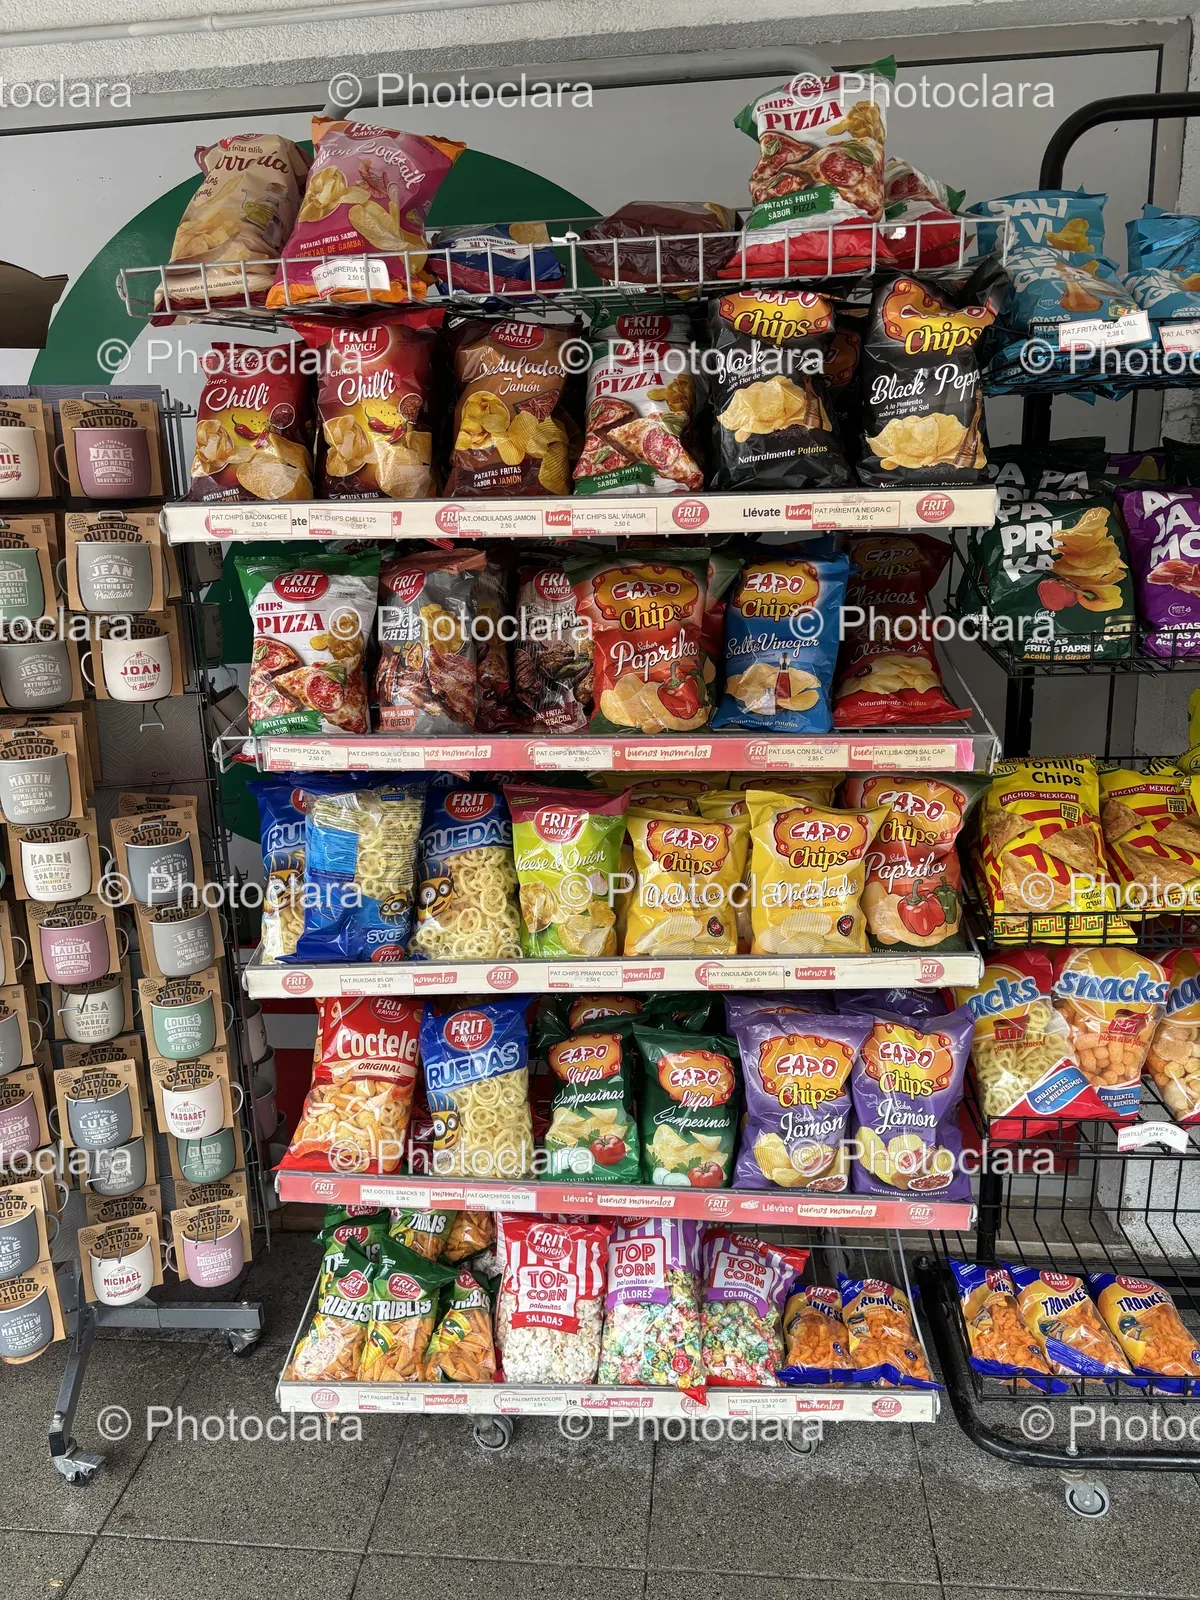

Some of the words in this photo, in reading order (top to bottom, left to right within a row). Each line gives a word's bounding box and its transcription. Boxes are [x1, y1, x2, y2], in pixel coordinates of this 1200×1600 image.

[764, 101, 843, 131] PIZZA
[763, 196, 793, 211] PATATAS
[795, 191, 820, 204] FRITAS
[988, 198, 1074, 218] SALT
[768, 208, 791, 221] SABOR
[793, 202, 817, 215] PIZZA
[300, 237, 323, 249] PATATAS
[323, 234, 339, 245] FRITAS
[340, 231, 358, 241] SABOR
[624, 315, 663, 328] FRIT
[733, 309, 810, 345] Chips
[339, 326, 383, 343] FRIT
[1062, 325, 1097, 336] PAT.FRITA
[498, 334, 531, 345] RAVICH
[904, 321, 984, 356] Chips
[337, 369, 396, 406] Chilli
[499, 377, 541, 395] Jamón
[595, 372, 664, 398] PIZZA
[206, 383, 270, 411] Chilli
[896, 398, 923, 410] Pimienta
[93, 450, 131, 459] JANE
[738, 448, 796, 465] Naturalmente
[798, 445, 828, 455] Patatas
[474, 469, 499, 480] PATATAS
[500, 466, 522, 475] FRITAS
[597, 478, 618, 488] SABOR
[619, 473, 642, 484] PIZZA
[203, 491, 222, 502] PATATAS
[223, 488, 240, 497] FRITAS
[677, 506, 703, 518] FRIT
[921, 499, 949, 511] FRIT
[211, 513, 243, 521] PAT.CHIPS
[245, 513, 288, 521] BACON&CHEE
[743, 506, 780, 520] Llévate
[92, 565, 133, 576] JEAN
[280, 574, 323, 587] FRIT
[392, 573, 423, 591] FRIT
[744, 572, 805, 594] CAPO
[95, 590, 133, 600] Predictable
[283, 585, 315, 595] RAVICH
[611, 581, 682, 601] CAPO
[257, 613, 325, 634] PIZZA
[620, 602, 682, 632] Chips
[610, 627, 698, 683] Paprika
[21, 662, 60, 676] JESSICA
[121, 664, 160, 675] JOAN
[25, 686, 62, 697] Predictable
[262, 717, 287, 729] PATATAS
[288, 715, 309, 723] FRITAS
[627, 747, 657, 757] buenos
[661, 747, 707, 759] momentos
[9, 774, 51, 788] MARTIN
[1032, 771, 1082, 787] Chips
[39, 791, 53, 799] MAN
[451, 793, 488, 807] FRIT
[1040, 792, 1077, 801] MEXICAN
[455, 805, 483, 813] RAVICH
[877, 791, 946, 821] CAPO
[1062, 804, 1078, 813] GLUTEN
[1169, 804, 1185, 812] FREE
[541, 812, 577, 828] FRIT
[1063, 810, 1077, 820] FREE
[790, 821, 853, 842] CAPO
[880, 818, 938, 847] Chips
[421, 822, 513, 858] RUEDAS
[663, 828, 720, 852] CAPO
[31, 852, 71, 866] KAREN
[150, 859, 188, 874] KEITH
[658, 851, 714, 877] Chips
[789, 847, 848, 872] Chips
[177, 928, 204, 943] LEE
[54, 944, 88, 955] LAURA
[286, 976, 308, 986] FRIT
[491, 971, 513, 981] FRIT
[1057, 969, 1171, 1004] snacks
[76, 1019, 109, 1027] SPARKLE
[166, 1015, 199, 1028] LOUISE
[451, 1019, 486, 1035] FRIT
[455, 1033, 483, 1043] RAVICH
[558, 1044, 608, 1064] CAPO
[879, 1043, 935, 1068] CAPO
[358, 1062, 401, 1074] ORIGINAL
[426, 1042, 520, 1090] RUEDAS
[776, 1054, 838, 1078] CAPO
[669, 1067, 721, 1087] CAPO
[879, 1070, 933, 1100] Chips
[1034, 1076, 1069, 1104] CRUJIENTES
[553, 1088, 625, 1111] Campesinas
[779, 1082, 837, 1111] Chips
[1101, 1092, 1134, 1101] CRUJIENTES
[79, 1113, 118, 1129] LUKE
[171, 1109, 206, 1120] MARGARET
[653, 1105, 730, 1133] Campesinas
[190, 1143, 219, 1157] MARY
[314, 1183, 336, 1192] FRIT
[708, 1199, 731, 1209] FRIT
[762, 1204, 794, 1213] Llévate
[799, 1205, 829, 1215] buenos
[830, 1205, 873, 1216] momentos
[909, 1207, 933, 1217] FRIT
[533, 1231, 565, 1248] FRIT
[198, 1251, 231, 1265] MICHELLE
[616, 1243, 655, 1262] TOP
[614, 1263, 656, 1278] CORN
[726, 1258, 767, 1276] TOP
[104, 1271, 141, 1286] MICHAEL
[528, 1270, 568, 1288] TOP
[723, 1268, 765, 1289] CORN
[1042, 1270, 1069, 1284] FRIT
[1120, 1275, 1146, 1288] FRIT
[526, 1289, 567, 1301] CORN
[617, 1289, 653, 1300] COLORES
[723, 1290, 759, 1304] COLORES
[529, 1302, 562, 1312] palomitas
[1, 1315, 41, 1336] MATTHEW
[526, 1314, 563, 1326] SALADAS
